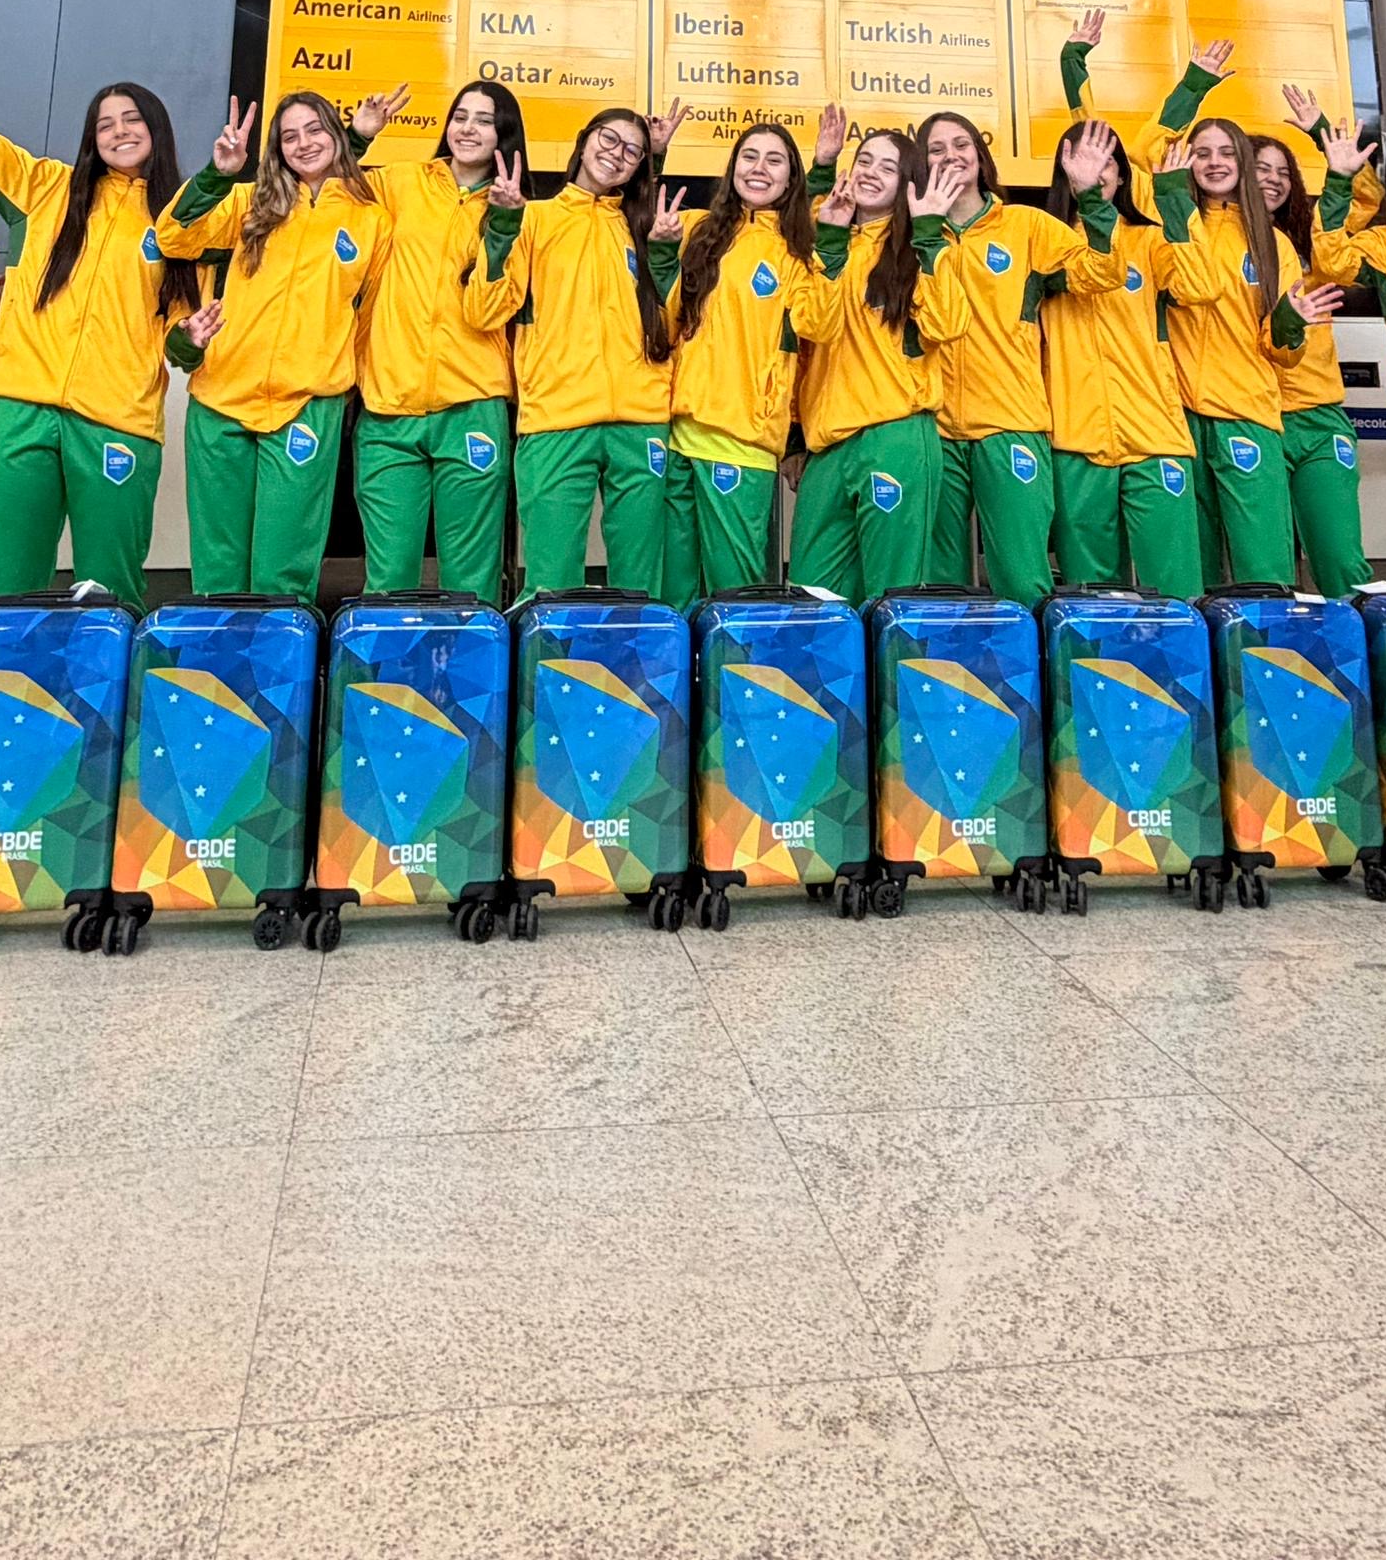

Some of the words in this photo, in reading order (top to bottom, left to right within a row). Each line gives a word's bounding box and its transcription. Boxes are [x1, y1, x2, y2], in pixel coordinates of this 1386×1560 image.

[407, 10, 453, 24] Airlines
[480, 12, 536, 36] KLM
[674, 13, 744, 37] Iberia
[845, 20, 933, 45] Turkish
[939, 33, 991, 49] Airlines
[291, 46, 352, 71] Azul
[558, 72, 615, 89] Airways
[677, 61, 800, 87] Lufthansa
[850, 70, 931, 96] United
[938, 83, 993, 99] Airlines
[388, 114, 437, 130] irways
[685, 106, 737, 123] South
[742, 109, 805, 127] African
[1295, 795, 1337, 815] CBDE
[582, 818, 631, 839] CBDE
[951, 817, 997, 838] CBDE
[1127, 809, 1172, 828] CBDE
[771, 819, 815, 840] CBDE
[185, 838, 237, 859] CBDE
[388, 842, 438, 864] CBDE
[594, 839, 618, 848] BRASIL
[1, 852, 30, 862] BRASIL
[197, 859, 224, 869] BRASIL
[401, 864, 427, 874] BRASIL
